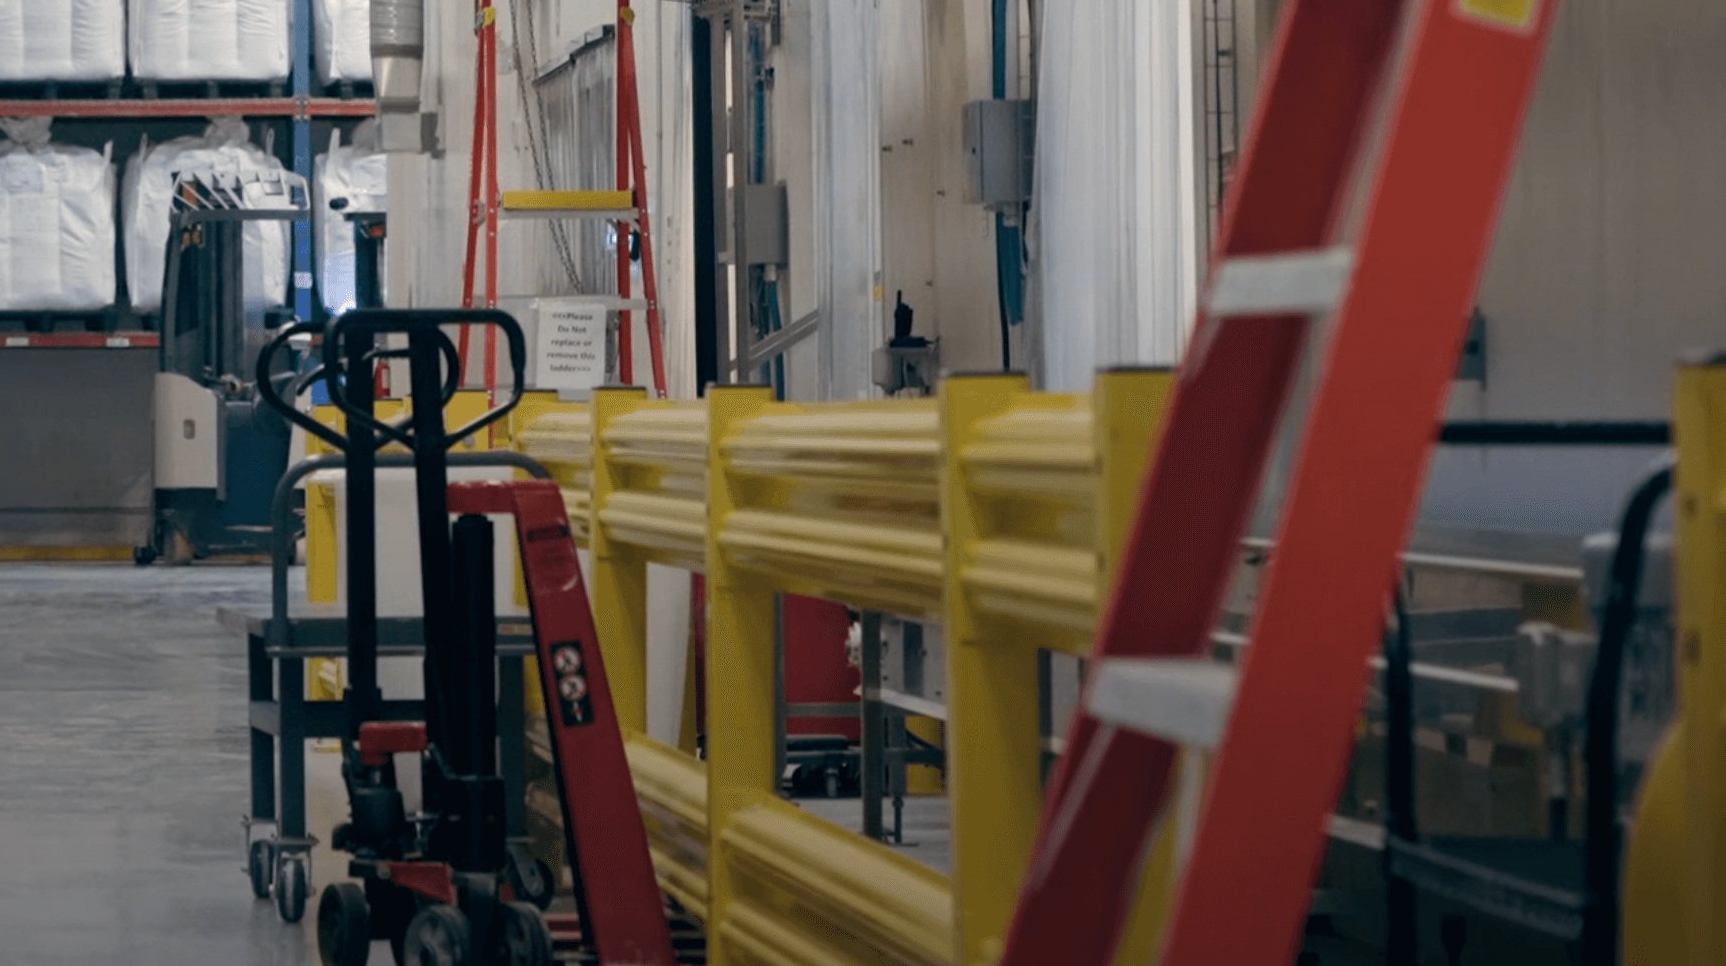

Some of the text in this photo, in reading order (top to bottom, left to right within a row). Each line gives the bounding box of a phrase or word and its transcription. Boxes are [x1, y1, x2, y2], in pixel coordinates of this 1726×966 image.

[557, 325, 587, 333] Do Not
[551, 338, 581, 347] replace
[580, 352, 595, 360] this
